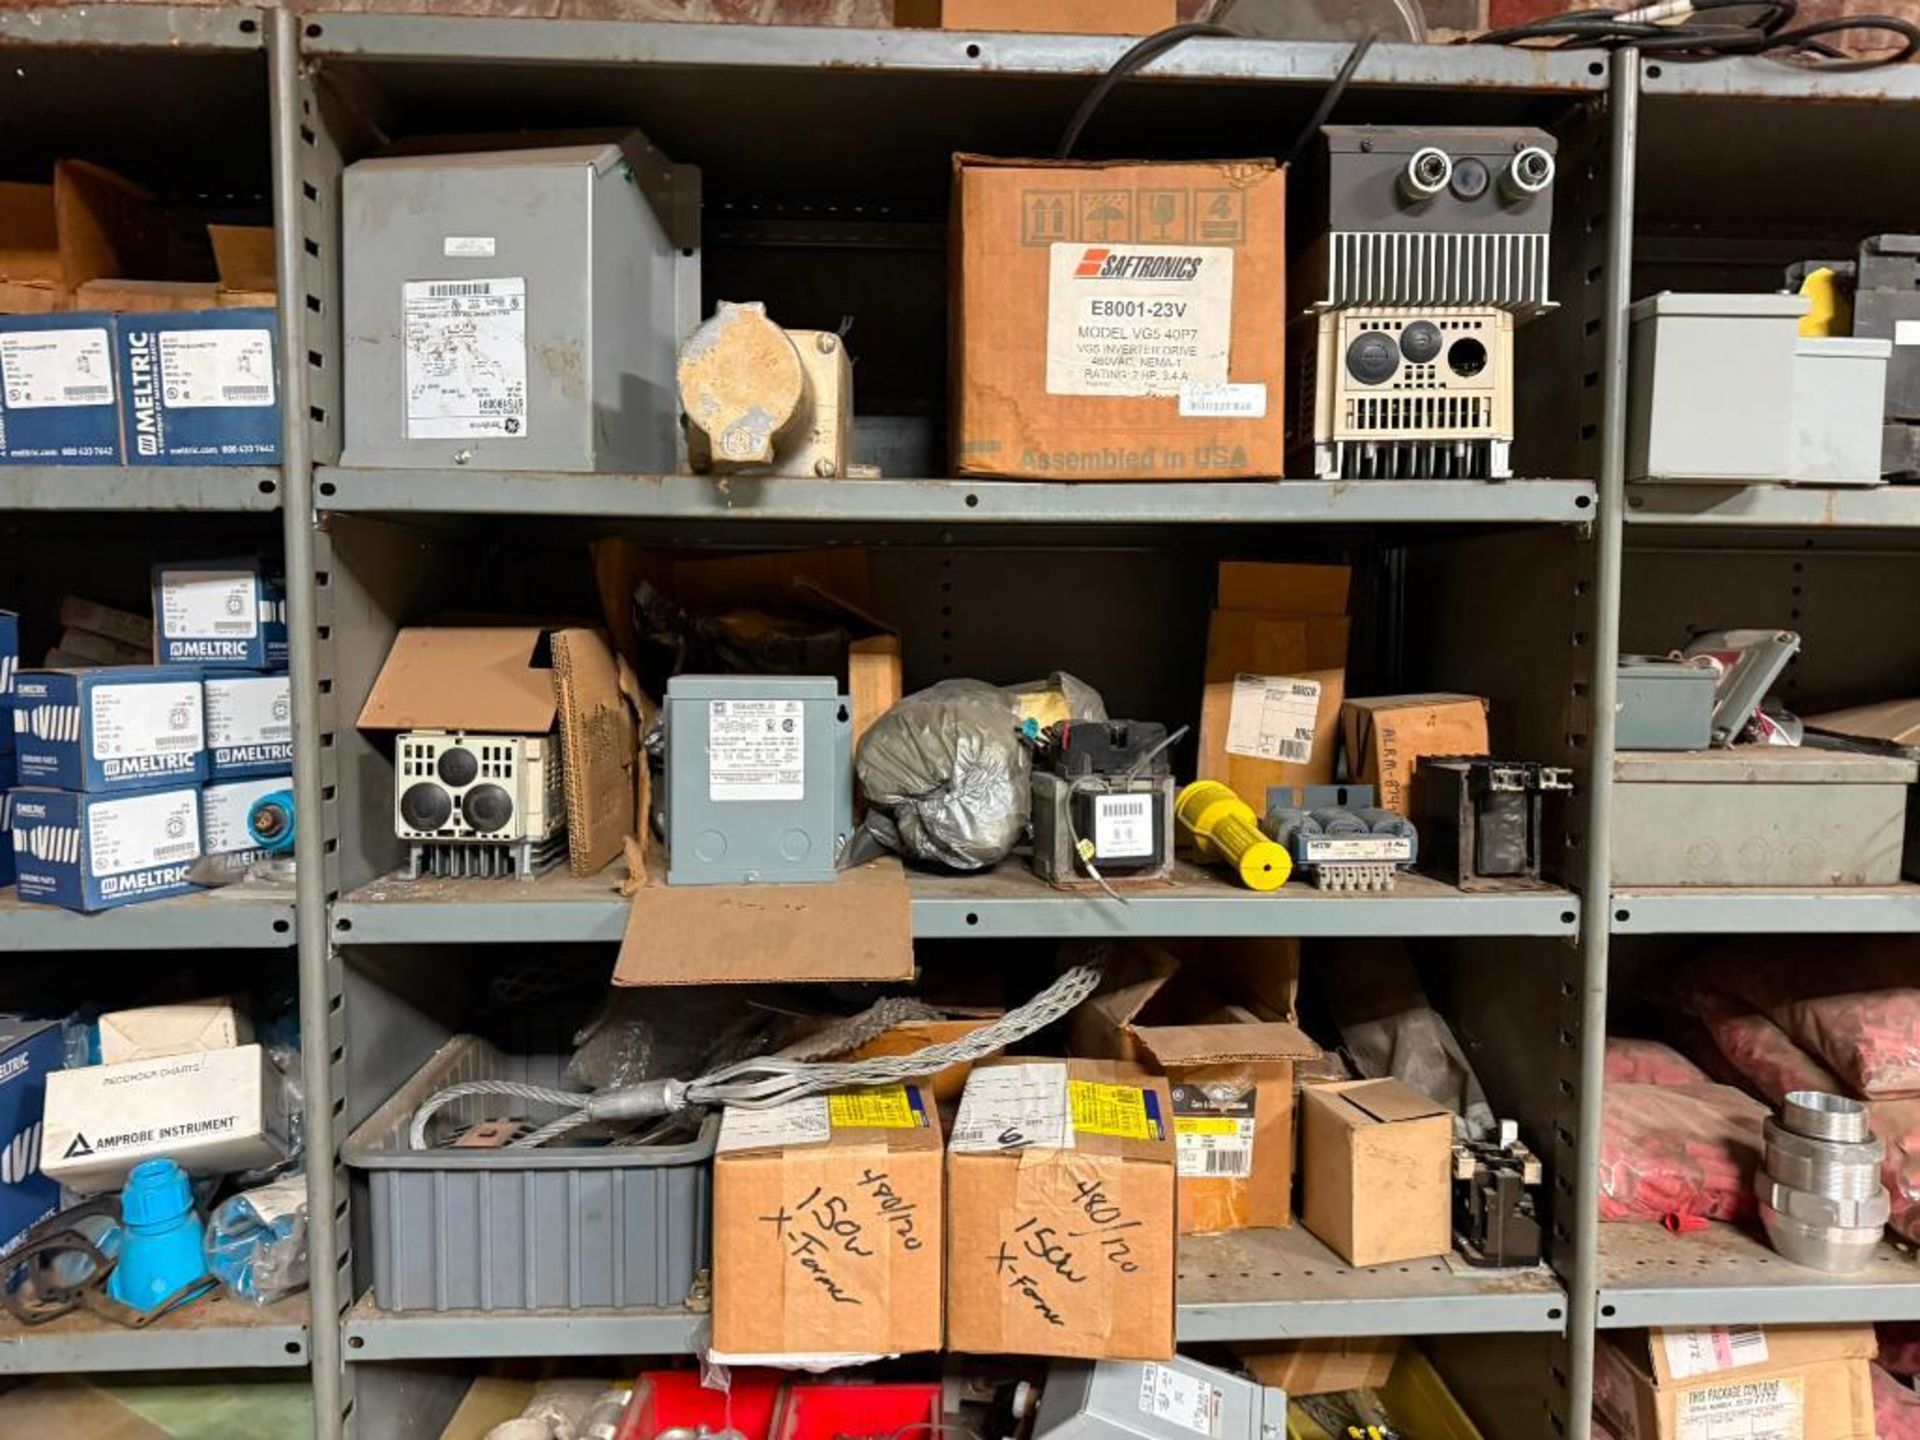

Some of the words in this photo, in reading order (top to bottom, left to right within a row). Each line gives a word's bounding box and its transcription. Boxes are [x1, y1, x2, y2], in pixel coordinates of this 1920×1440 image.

[1101, 255, 1203, 279] SAFTRONICS
[1091, 300, 1187, 318] E8001-23V
[1078, 326, 1129, 340] MODEL
[1132, 327, 1161, 341] VG5
[1164, 328, 1199, 341] 40P7
[1103, 344, 1161, 356] INVERTER
[129, 332, 156, 433] MELTRIC
[1019, 446, 1154, 471] Assembled
[1163, 446, 1185, 470] in
[1194, 445, 1248, 469] USA
[183, 641, 248, 657] MELTRIC
[121, 752, 195, 774] MELTRIC
[231, 744, 293, 763] MELTRIC
[119, 865, 191, 891] MELTRIC
[103, 1071, 158, 1086] RECORDER
[160, 1063, 200, 1078] CHARTS
[96, 1130, 157, 1149] AMPROBE
[159, 1116, 236, 1139] INSTRUMENT
[857, 1169, 923, 1250] 480/120
[1068, 1181, 1143, 1273] 480/120
[1689, 1391, 1705, 1405] THIS
[1707, 1384, 1742, 1402] PACKAGE
